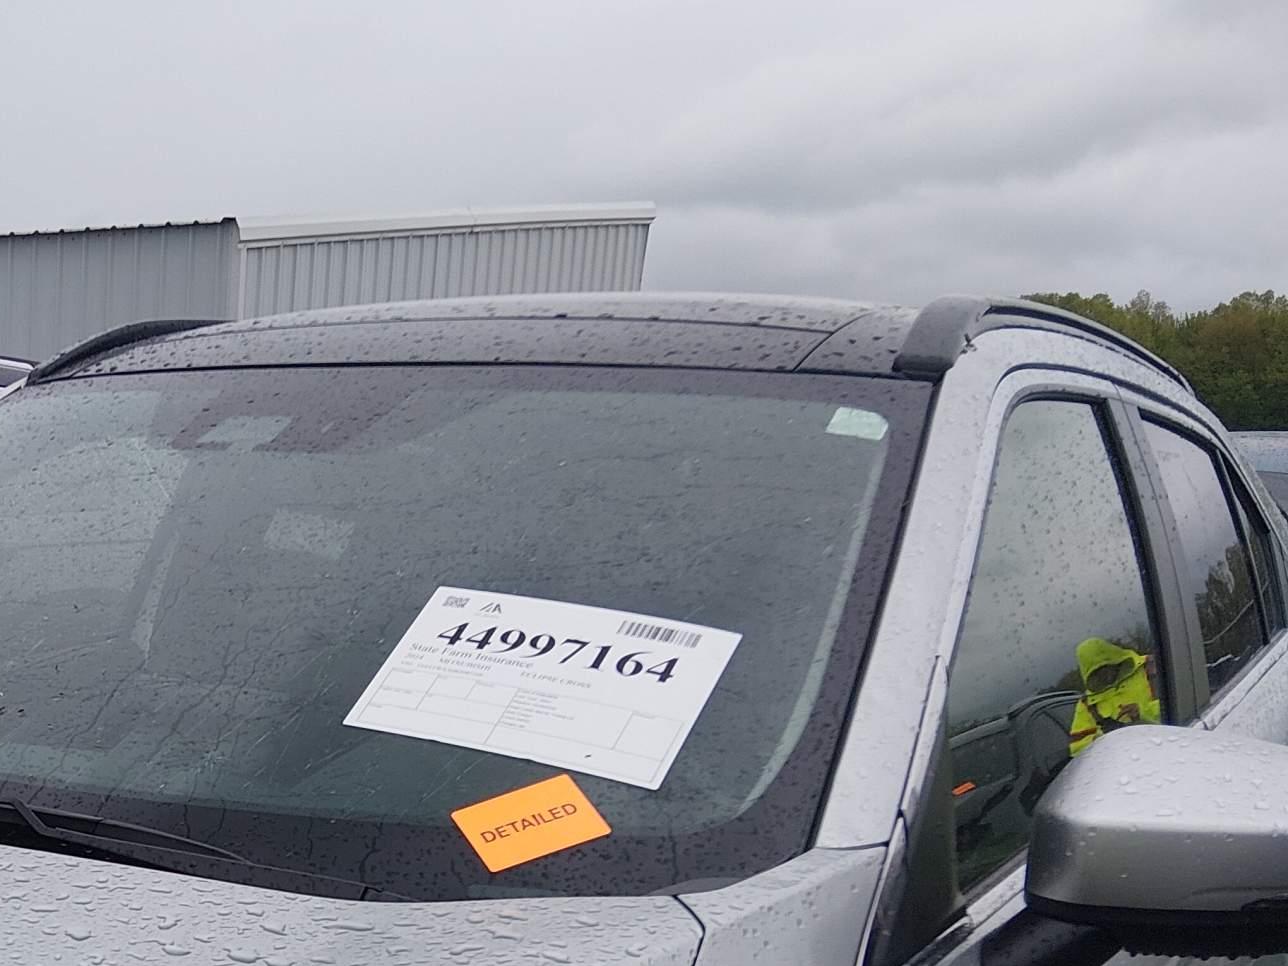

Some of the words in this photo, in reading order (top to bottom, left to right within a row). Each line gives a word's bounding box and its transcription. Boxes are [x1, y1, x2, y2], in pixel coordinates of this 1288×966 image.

[411, 643, 439, 655] State
[442, 647, 472, 660] Farm
[476, 651, 534, 669] Insurance
[437, 622, 680, 684] 44997164
[480, 803, 577, 844] DETAILED
